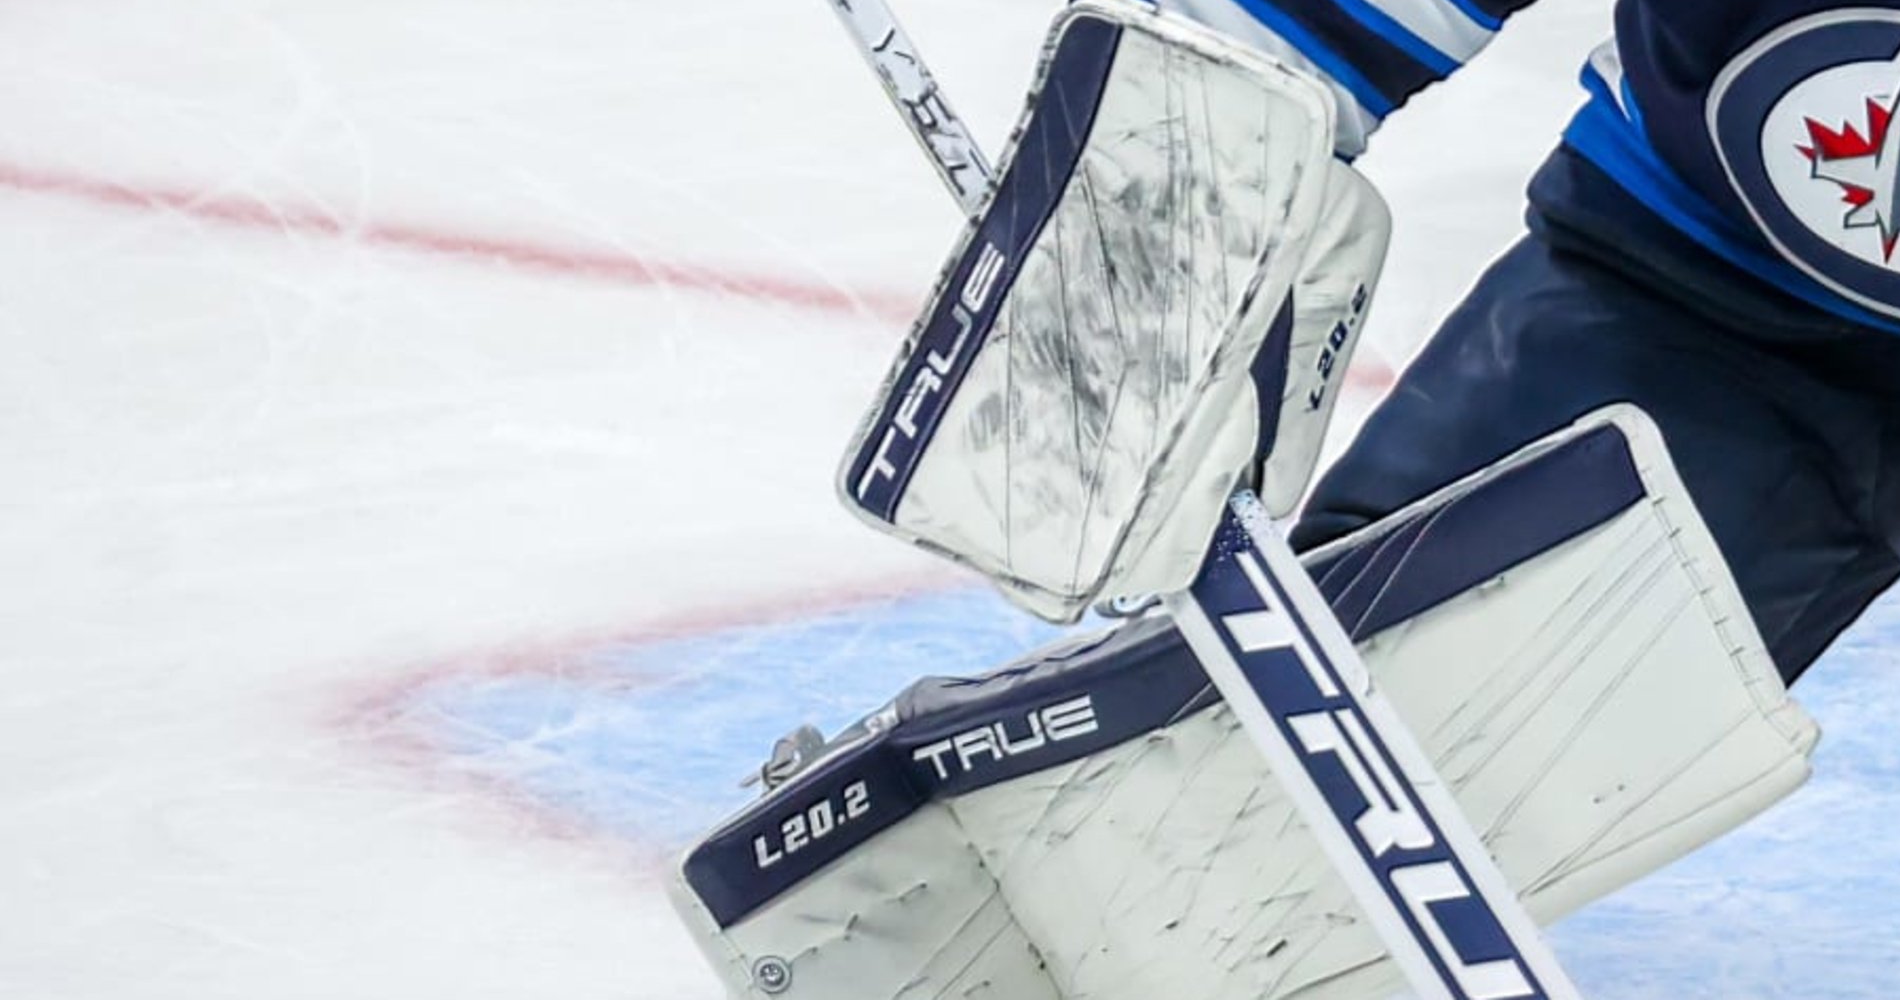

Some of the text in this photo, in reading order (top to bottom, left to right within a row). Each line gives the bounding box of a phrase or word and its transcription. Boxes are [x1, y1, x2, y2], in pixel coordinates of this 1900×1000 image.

[857, 241, 1005, 500] TRUE
[1308, 283, 1368, 411] L20.2
[913, 694, 1099, 780] TRUE
[753, 780, 870, 869] L20.2
